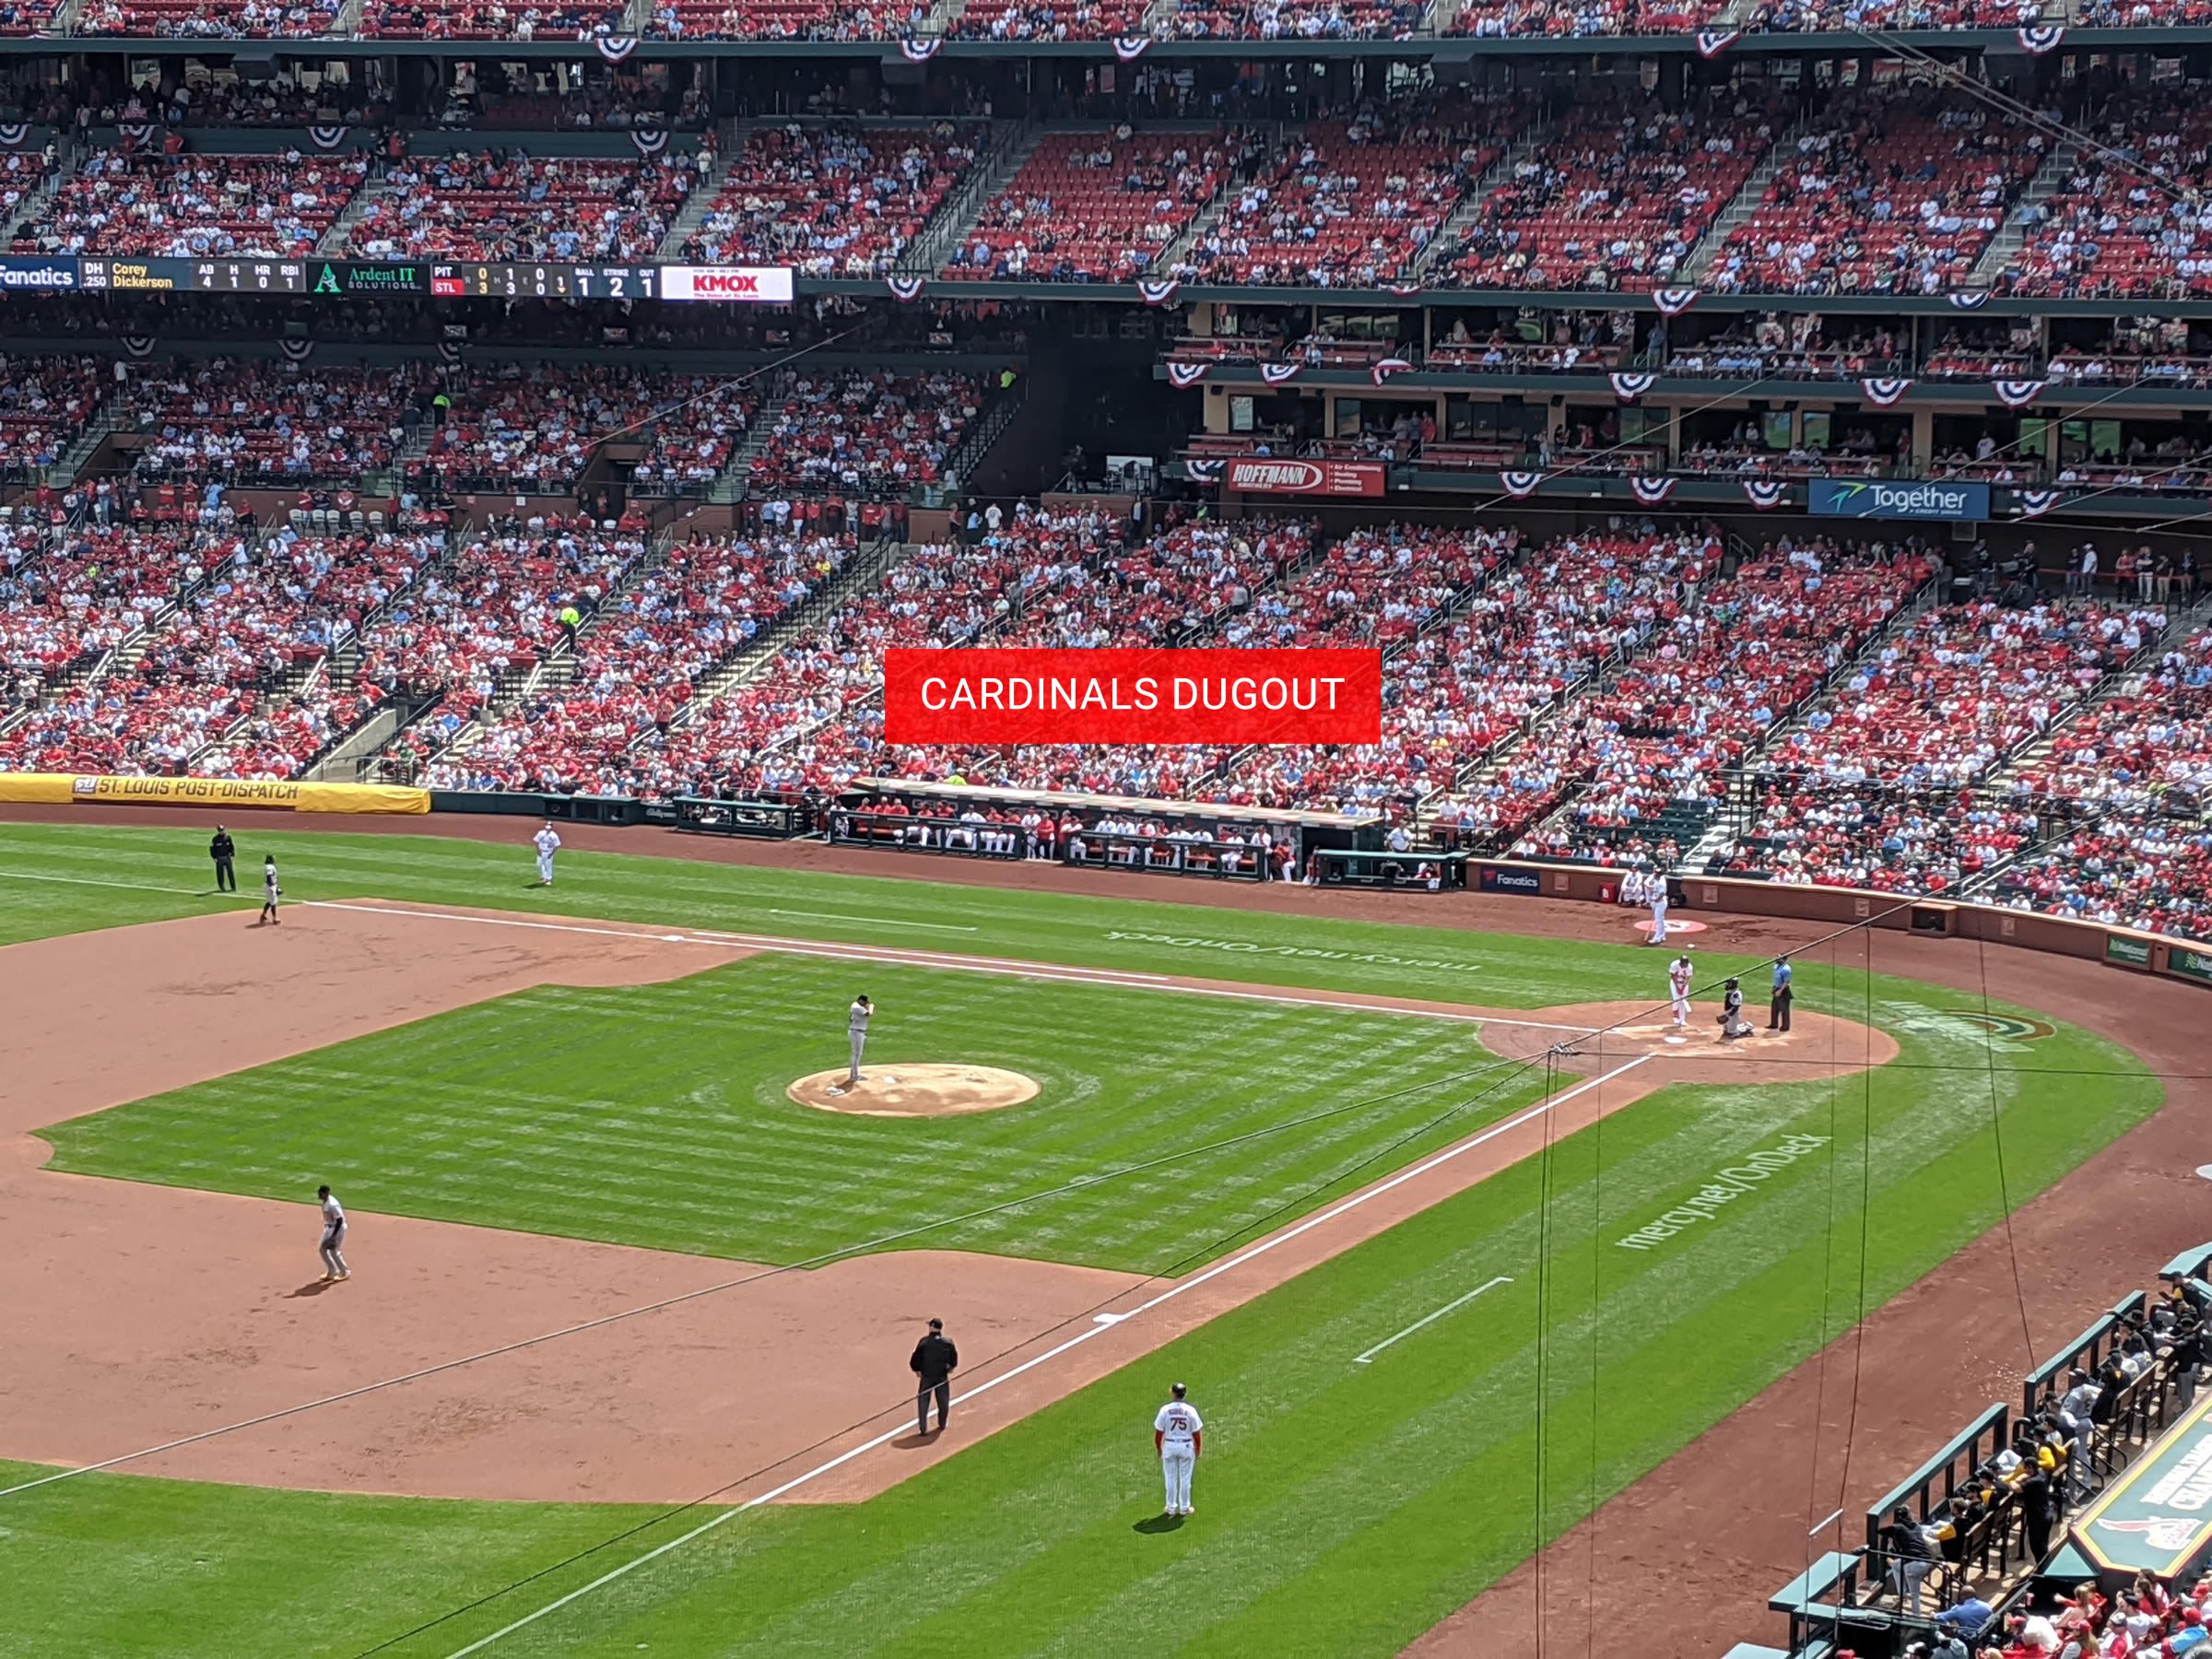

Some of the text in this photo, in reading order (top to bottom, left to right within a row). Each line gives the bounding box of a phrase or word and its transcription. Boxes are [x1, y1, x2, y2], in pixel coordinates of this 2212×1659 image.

[85, 263, 103, 275] DH
[112, 263, 147, 276] Corey
[199, 264, 300, 276] AB H HR RBI
[348, 266, 416, 282] Ardent IT
[434, 266, 545, 280] PIT 0 1 0
[574, 267, 595, 276] BALL
[603, 268, 629, 276] STRIKE
[83, 276, 107, 288] .250
[112, 276, 173, 288] Dickerson
[203, 276, 293, 289] 4 1 0 1
[348, 281, 416, 290] SOLUTIONS
[435, 282, 545, 295] STL 3 3 0
[557, 276, 564, 287] 1
[578, 277, 653, 297] 1 2 1
[693, 275, 759, 292] KMOX
[1232, 464, 1309, 485] HOFFMANN
[1869, 485, 1968, 513] Together
[99, 778, 121, 794] ST.
[124, 780, 171, 795] LOUIS
[175, 781, 298, 799] POST-DISPATCH
[1496, 873, 1538, 888] Fanatics
[1104, 930, 1482, 972] mercy.net/OnDeck
[1615, 1133, 1833, 1251] mercy.net/OnDeck
[1170, 1417, 1187, 1431] 75
